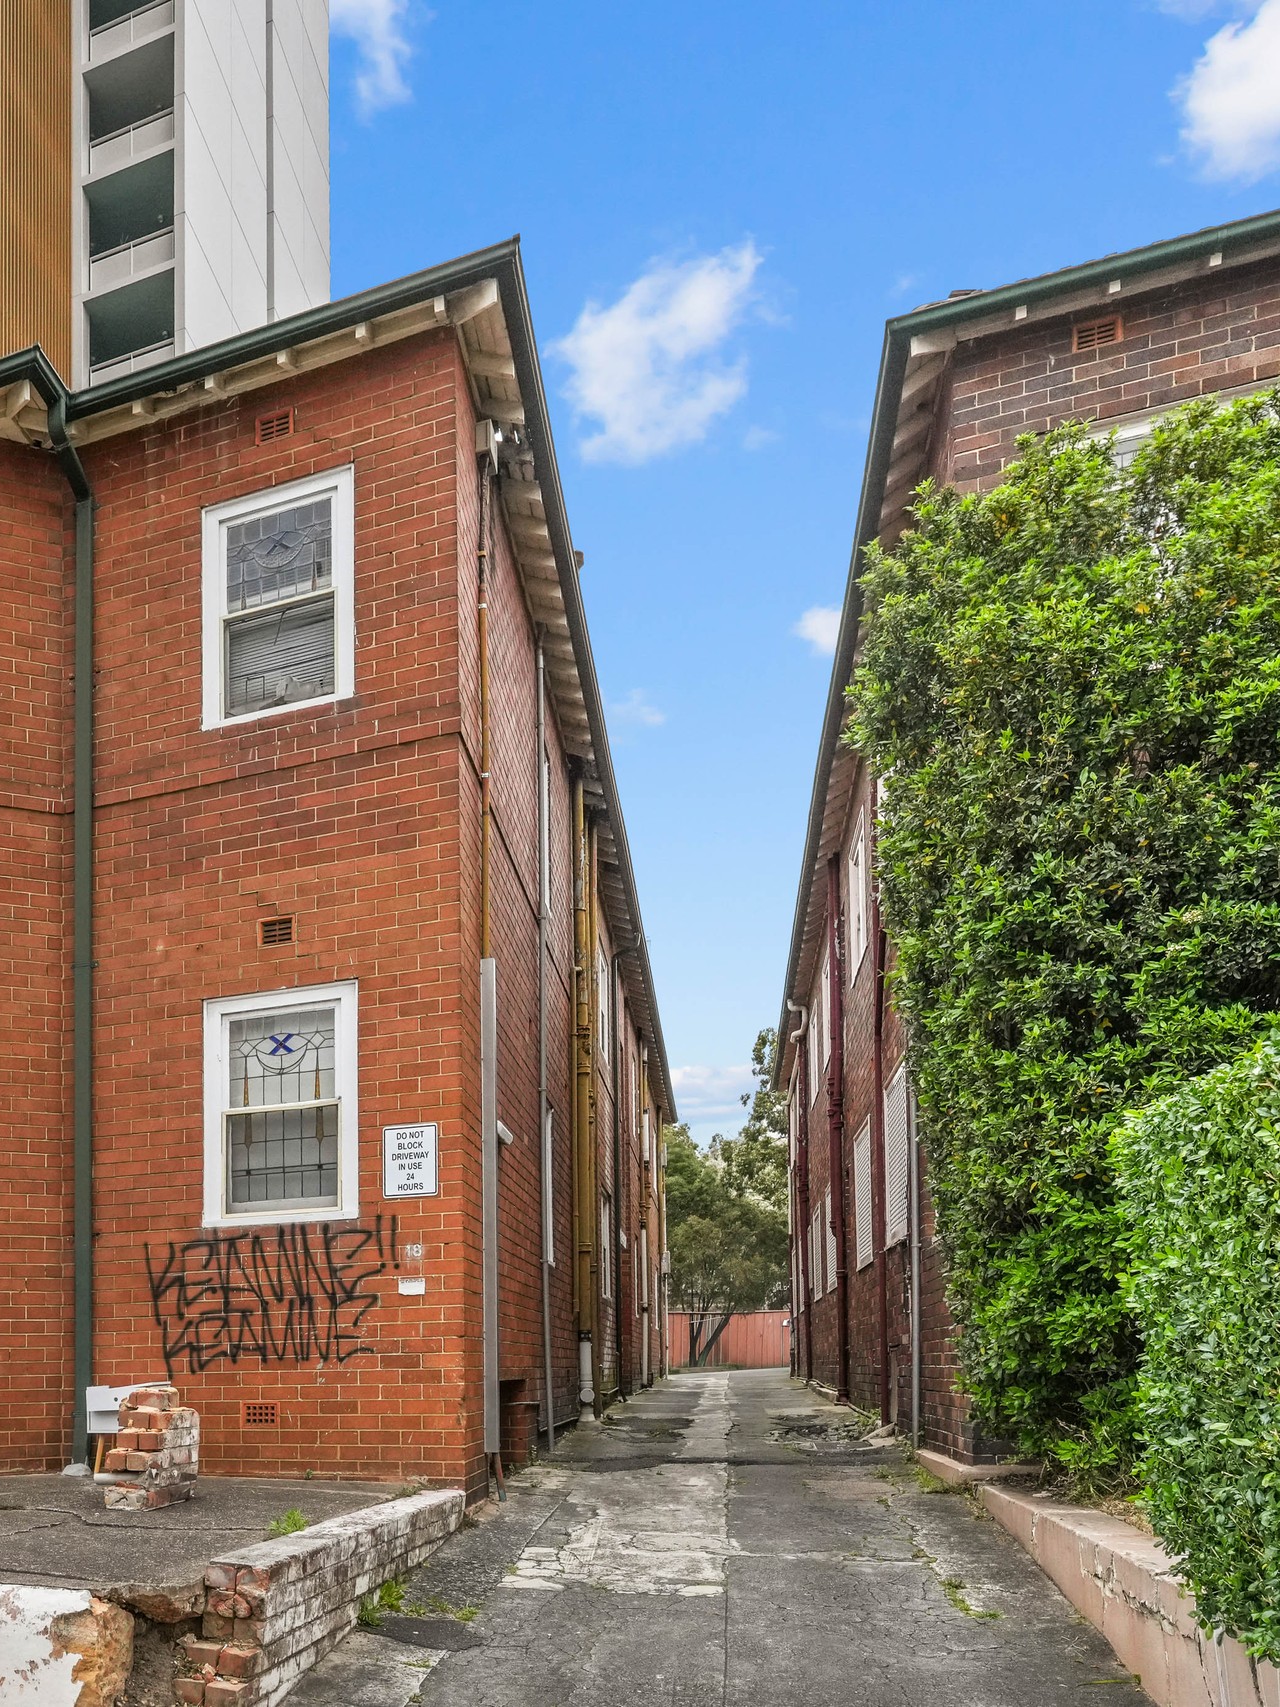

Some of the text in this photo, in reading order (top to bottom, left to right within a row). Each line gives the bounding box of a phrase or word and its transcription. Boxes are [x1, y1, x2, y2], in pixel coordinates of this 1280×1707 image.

[396, 1130, 424, 1140] DO NOT
[398, 1141, 423, 1150] BLOCK
[391, 1151, 429, 1161] DRIVEWAY
[408, 1162, 422, 1170] USE
[398, 1182, 424, 1191] HOURS
[405, 1243, 422, 1258] 18
